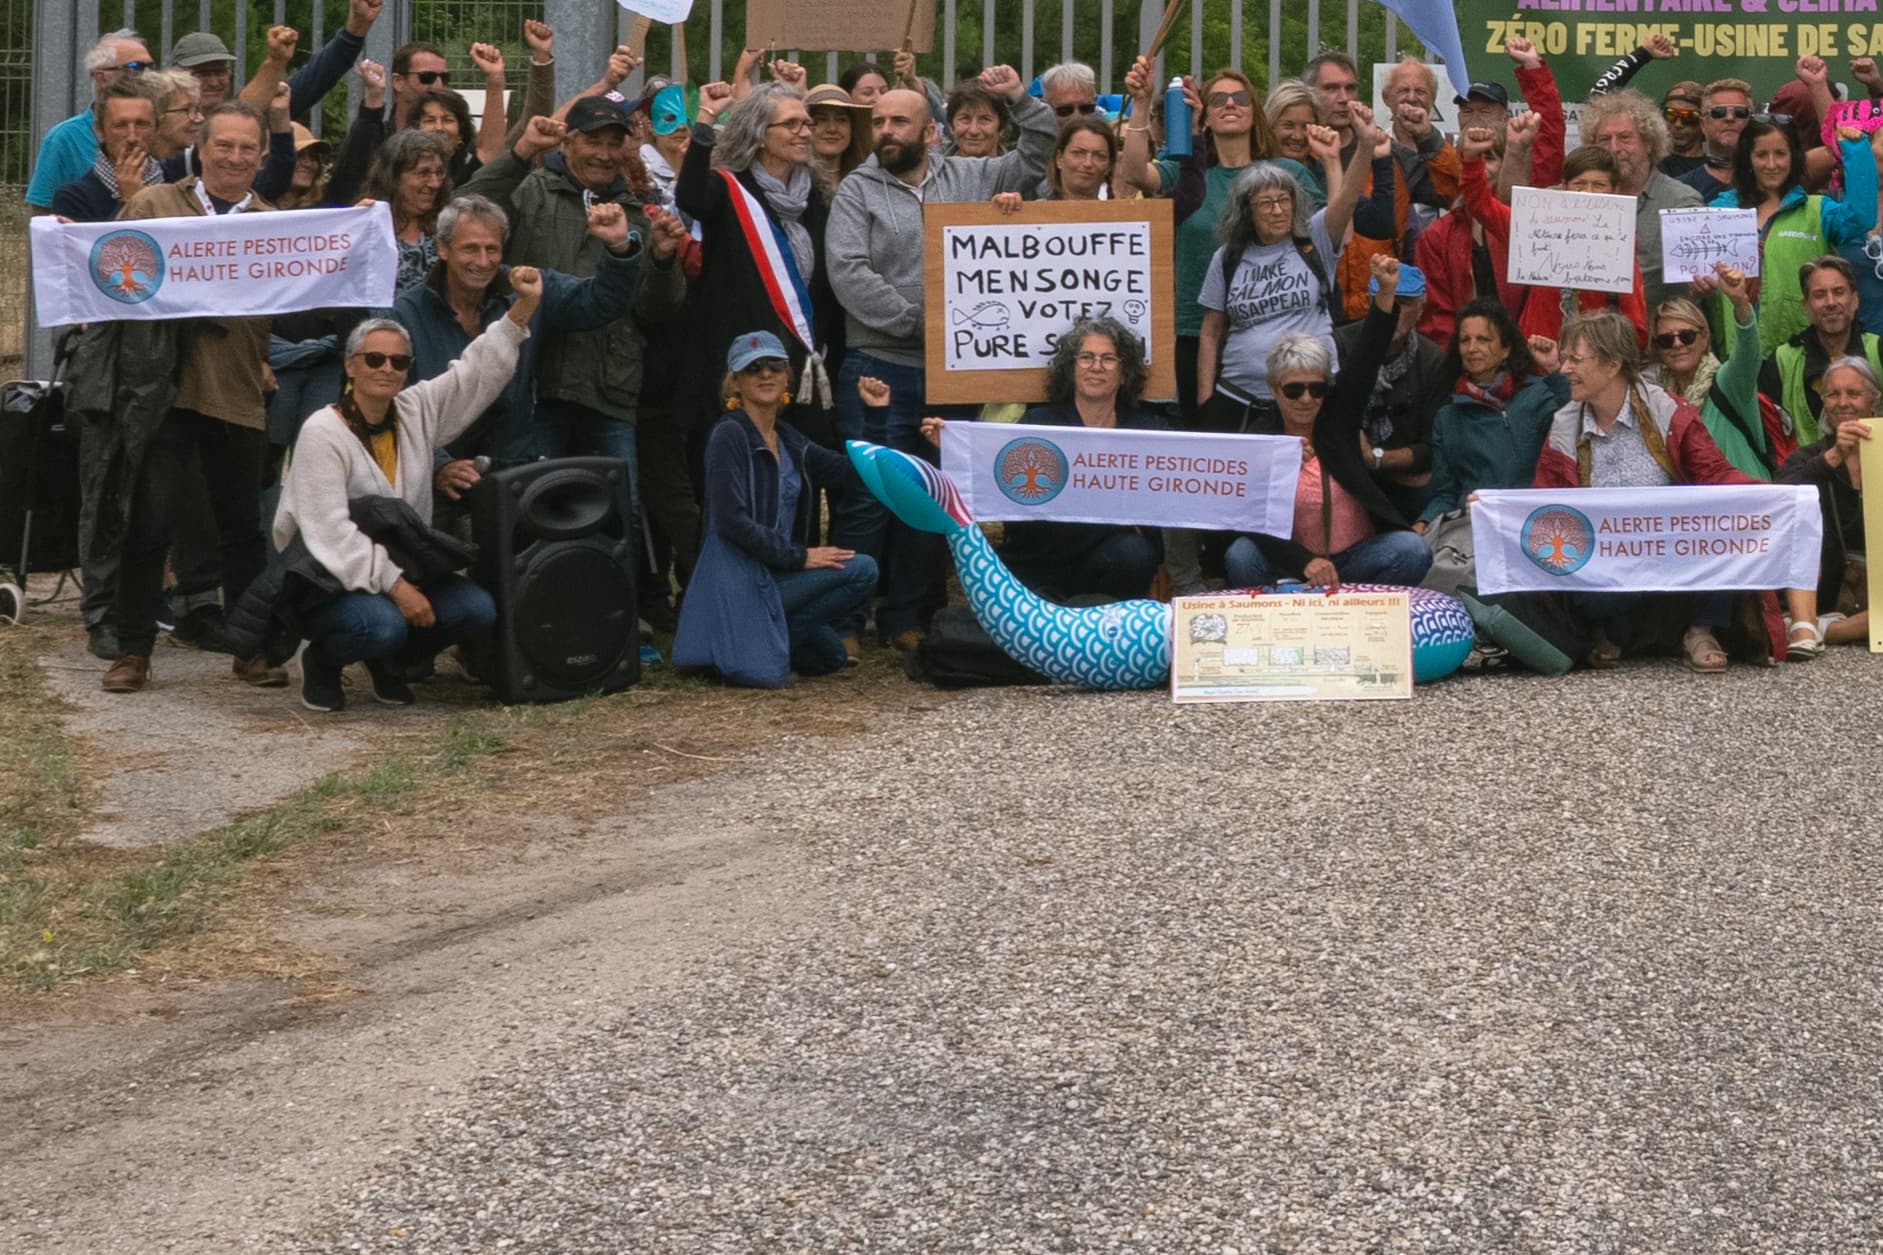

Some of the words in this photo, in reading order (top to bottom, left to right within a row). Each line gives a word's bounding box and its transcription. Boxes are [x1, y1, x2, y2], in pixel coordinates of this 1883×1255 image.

[1485, 13, 1567, 55] ZÉRO
[1576, 23, 1788, 57] FERME-USINE
[1797, 24, 1838, 57] DE
[1517, 195, 1552, 209] NON
[168, 240, 237, 259] ALERTE
[243, 234, 351, 256] PESTICIDES
[952, 233, 1145, 260] MALBOUFFE
[170, 263, 239, 282] HAUTE
[248, 257, 348, 279] GIRONDE
[956, 268, 1145, 294] MENSONGE
[1227, 271, 1308, 304] SALMON
[1018, 299, 1112, 321] VOTEZ
[954, 329, 1030, 359] PURE
[1073, 452, 1138, 469] ALERTE
[1145, 455, 1248, 476] PESTICIDES
[1073, 474, 1139, 491] HAUTE
[1148, 477, 1246, 497] GIRONDE
[1598, 517, 1663, 533] ALERTE
[1670, 515, 1772, 532] PESTICIDES
[1599, 540, 1665, 557] HAUTE
[1674, 538, 1769, 556] GIRONDE
[1182, 601, 1215, 610] Usine
[1218, 599, 1226, 609] à
[1229, 600, 1282, 609] Saumons
[1292, 599, 1305, 607] Ni
[1328, 598, 1339, 607] ni
[1343, 597, 1384, 607] ailleurs
